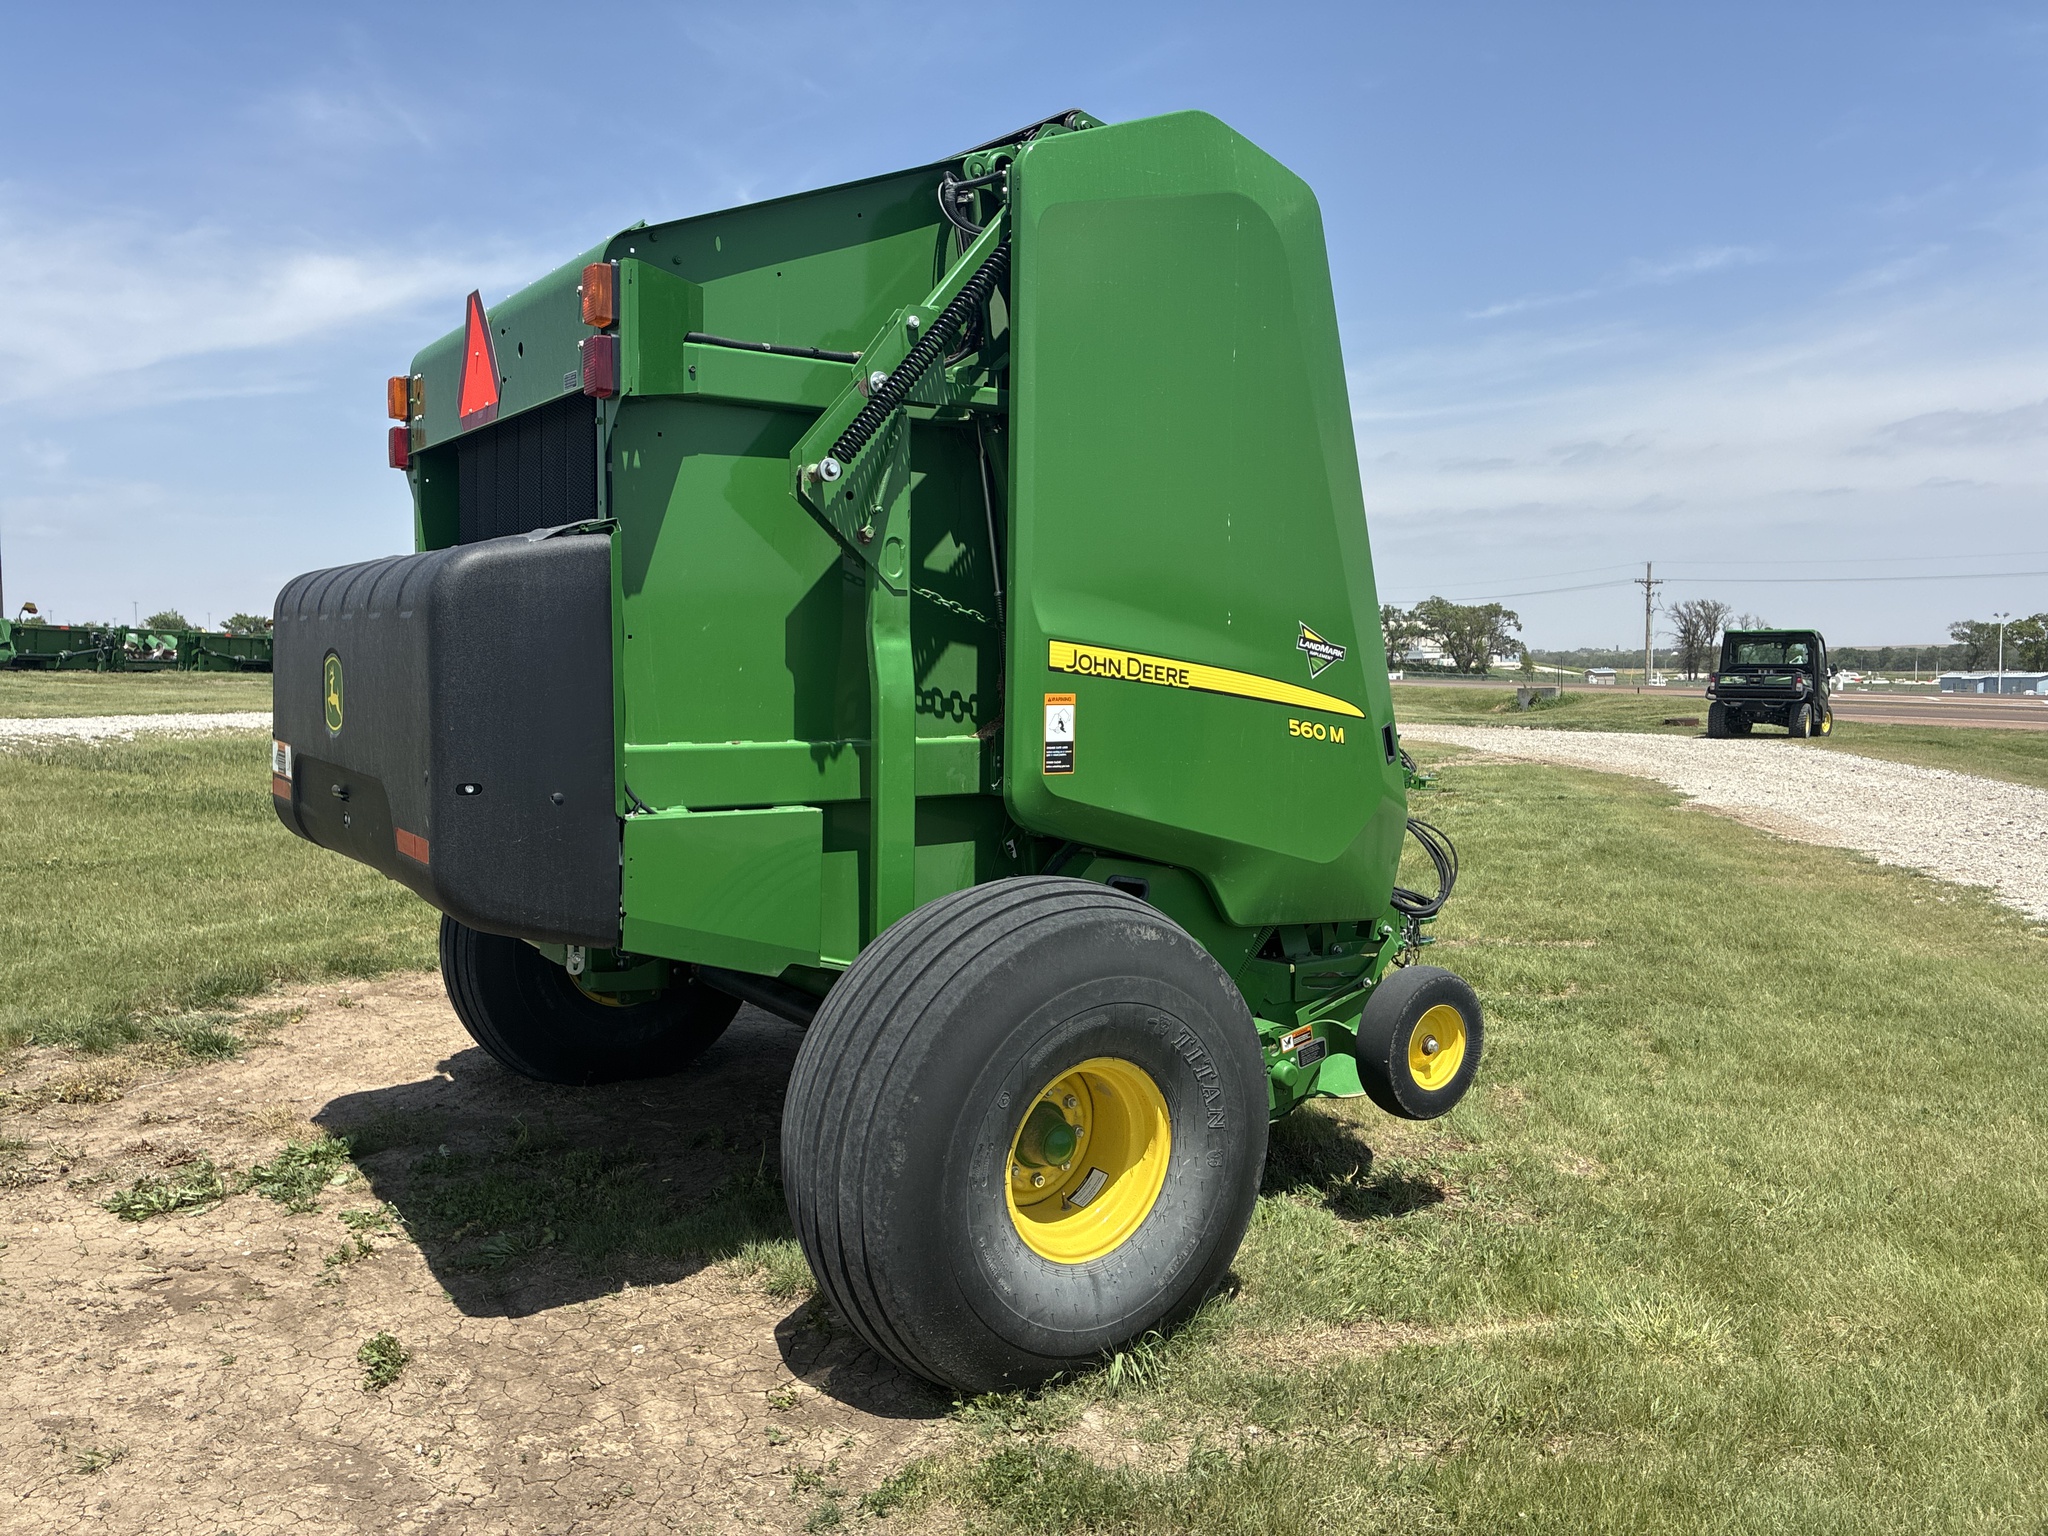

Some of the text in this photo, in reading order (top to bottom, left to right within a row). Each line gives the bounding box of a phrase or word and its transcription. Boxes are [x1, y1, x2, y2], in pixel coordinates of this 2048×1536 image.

[1299, 638, 1343, 658] LANDMARK
[1309, 651, 1333, 660] IMPLEMENT
[1066, 649, 1190, 686] JOHN DEERE
[1288, 718, 1326, 741] 560
[1171, 1027, 1226, 1131] TITAN
